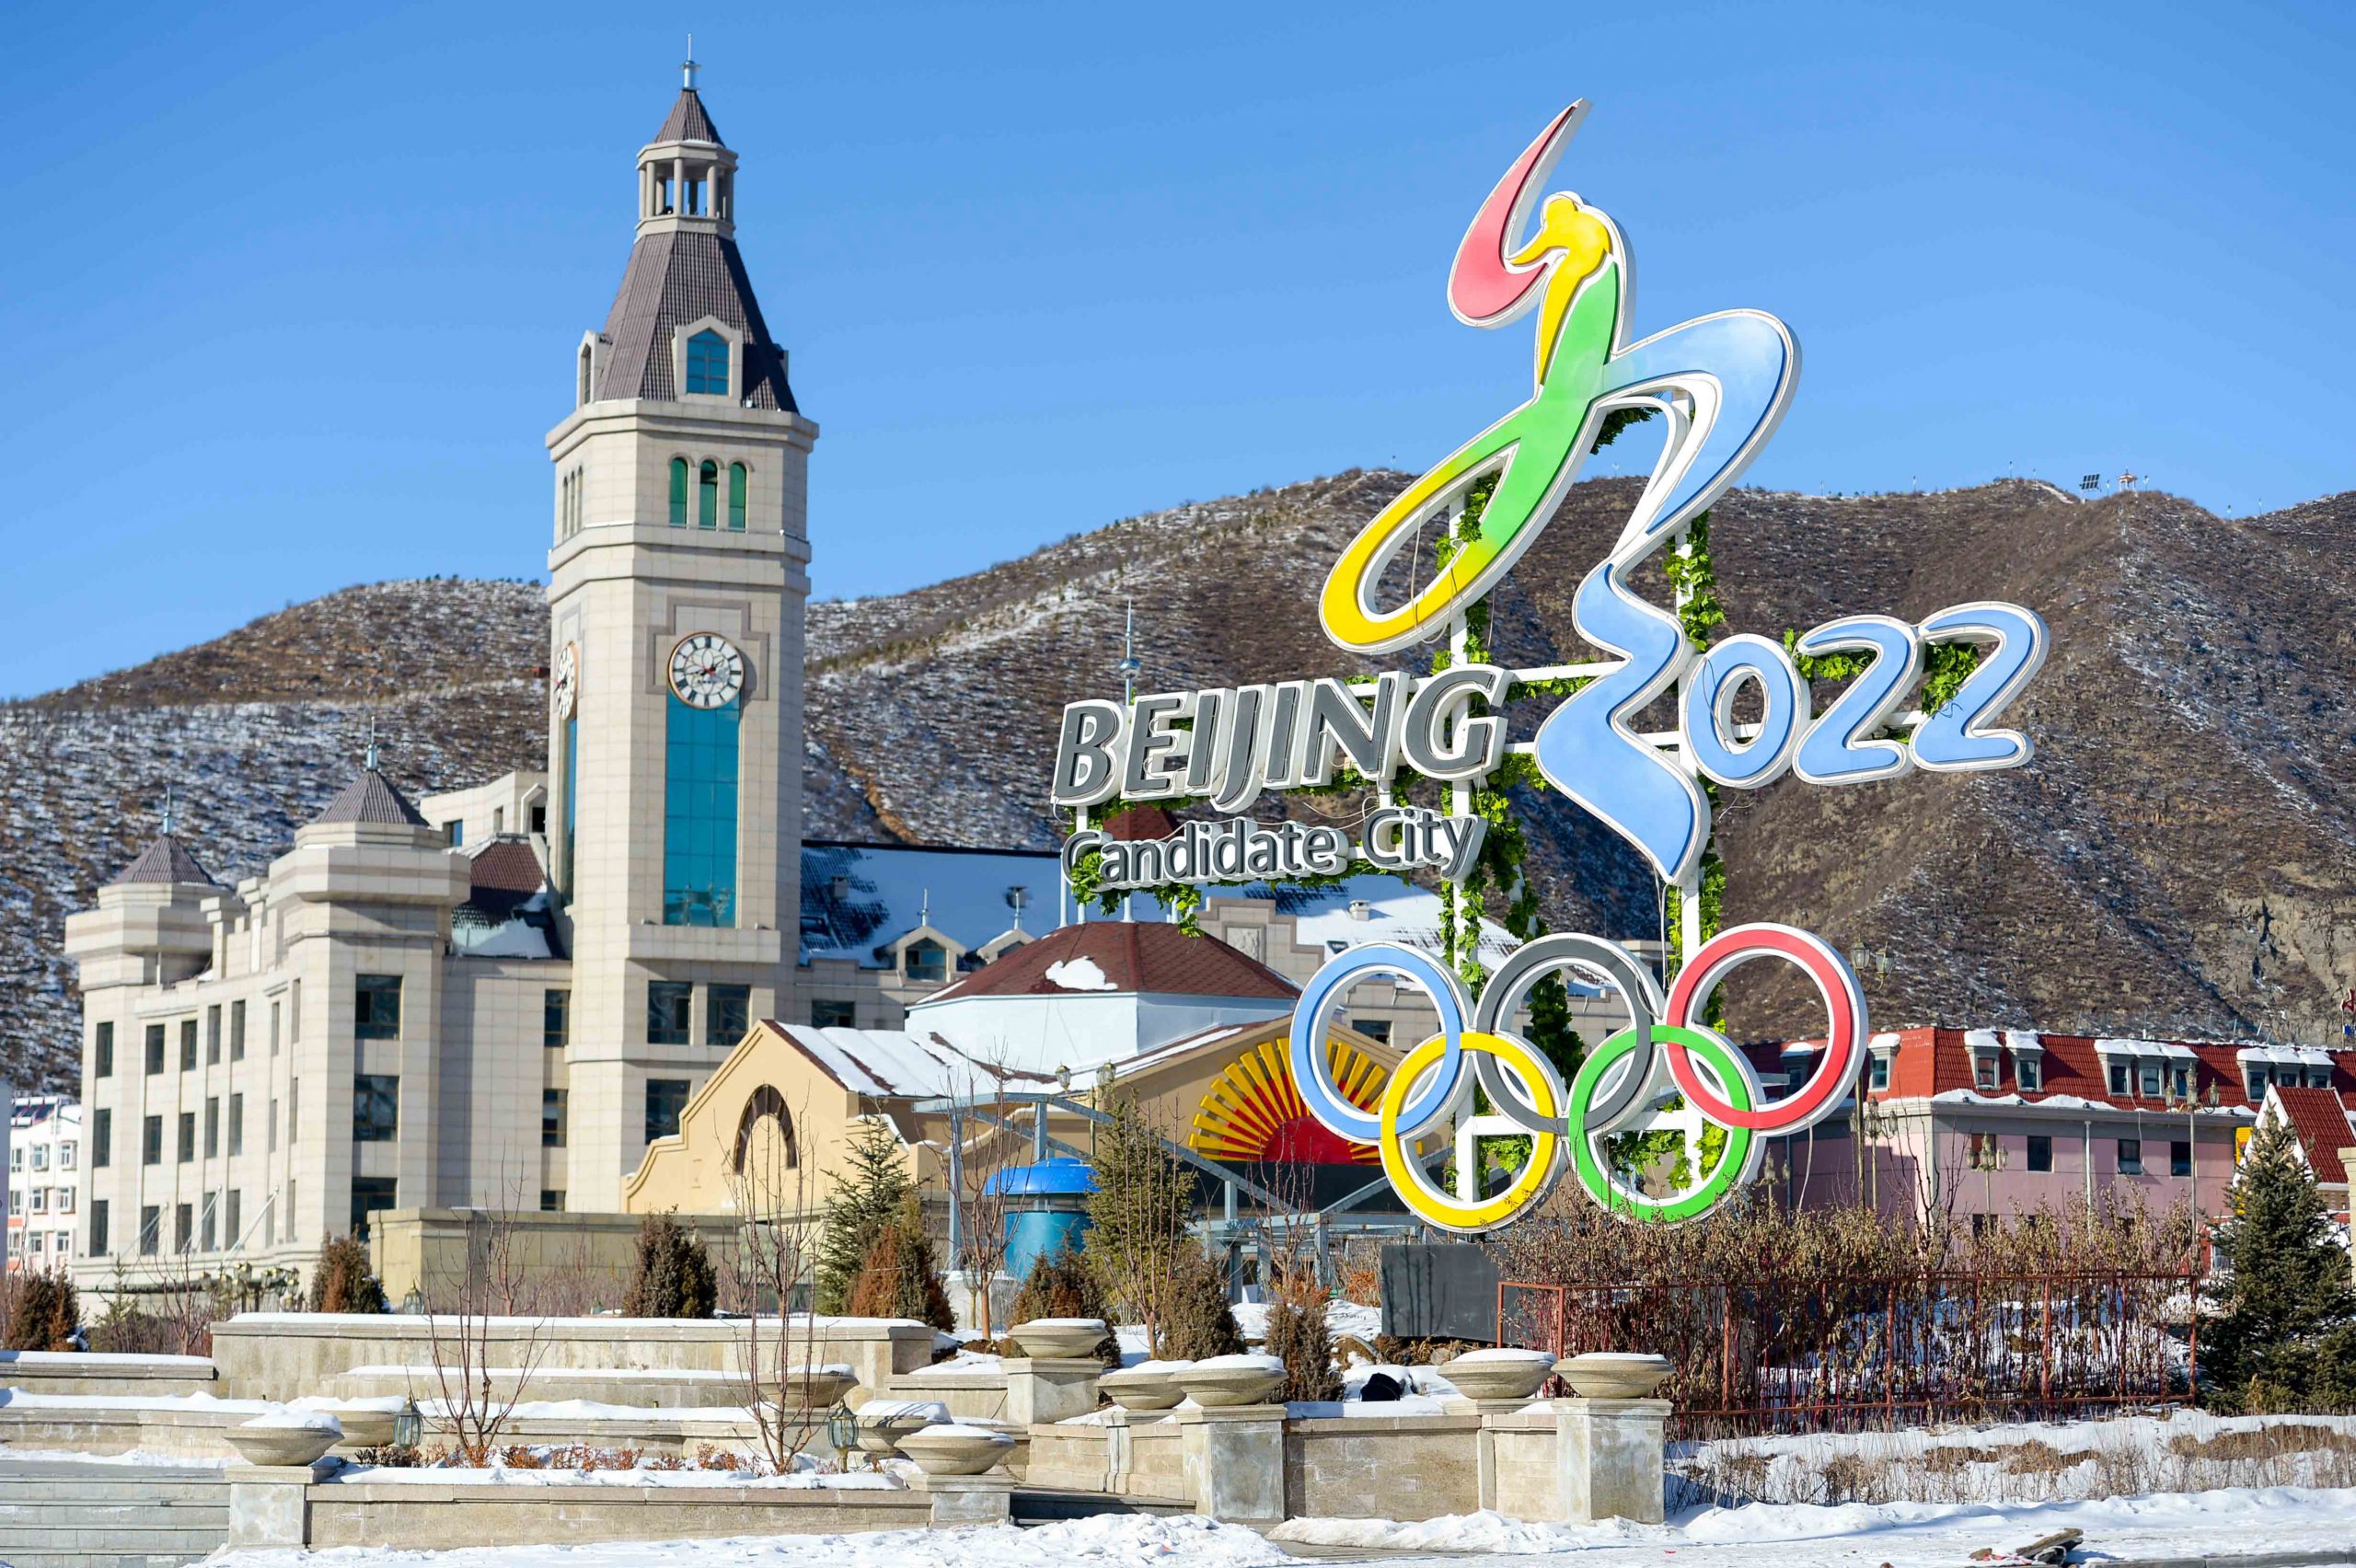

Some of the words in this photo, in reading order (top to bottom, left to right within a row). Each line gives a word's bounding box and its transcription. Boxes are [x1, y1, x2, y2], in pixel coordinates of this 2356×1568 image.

[1053, 666, 1509, 811] BEIJING
[1061, 818, 1342, 890] Candidate
[1361, 808, 1480, 880] City
